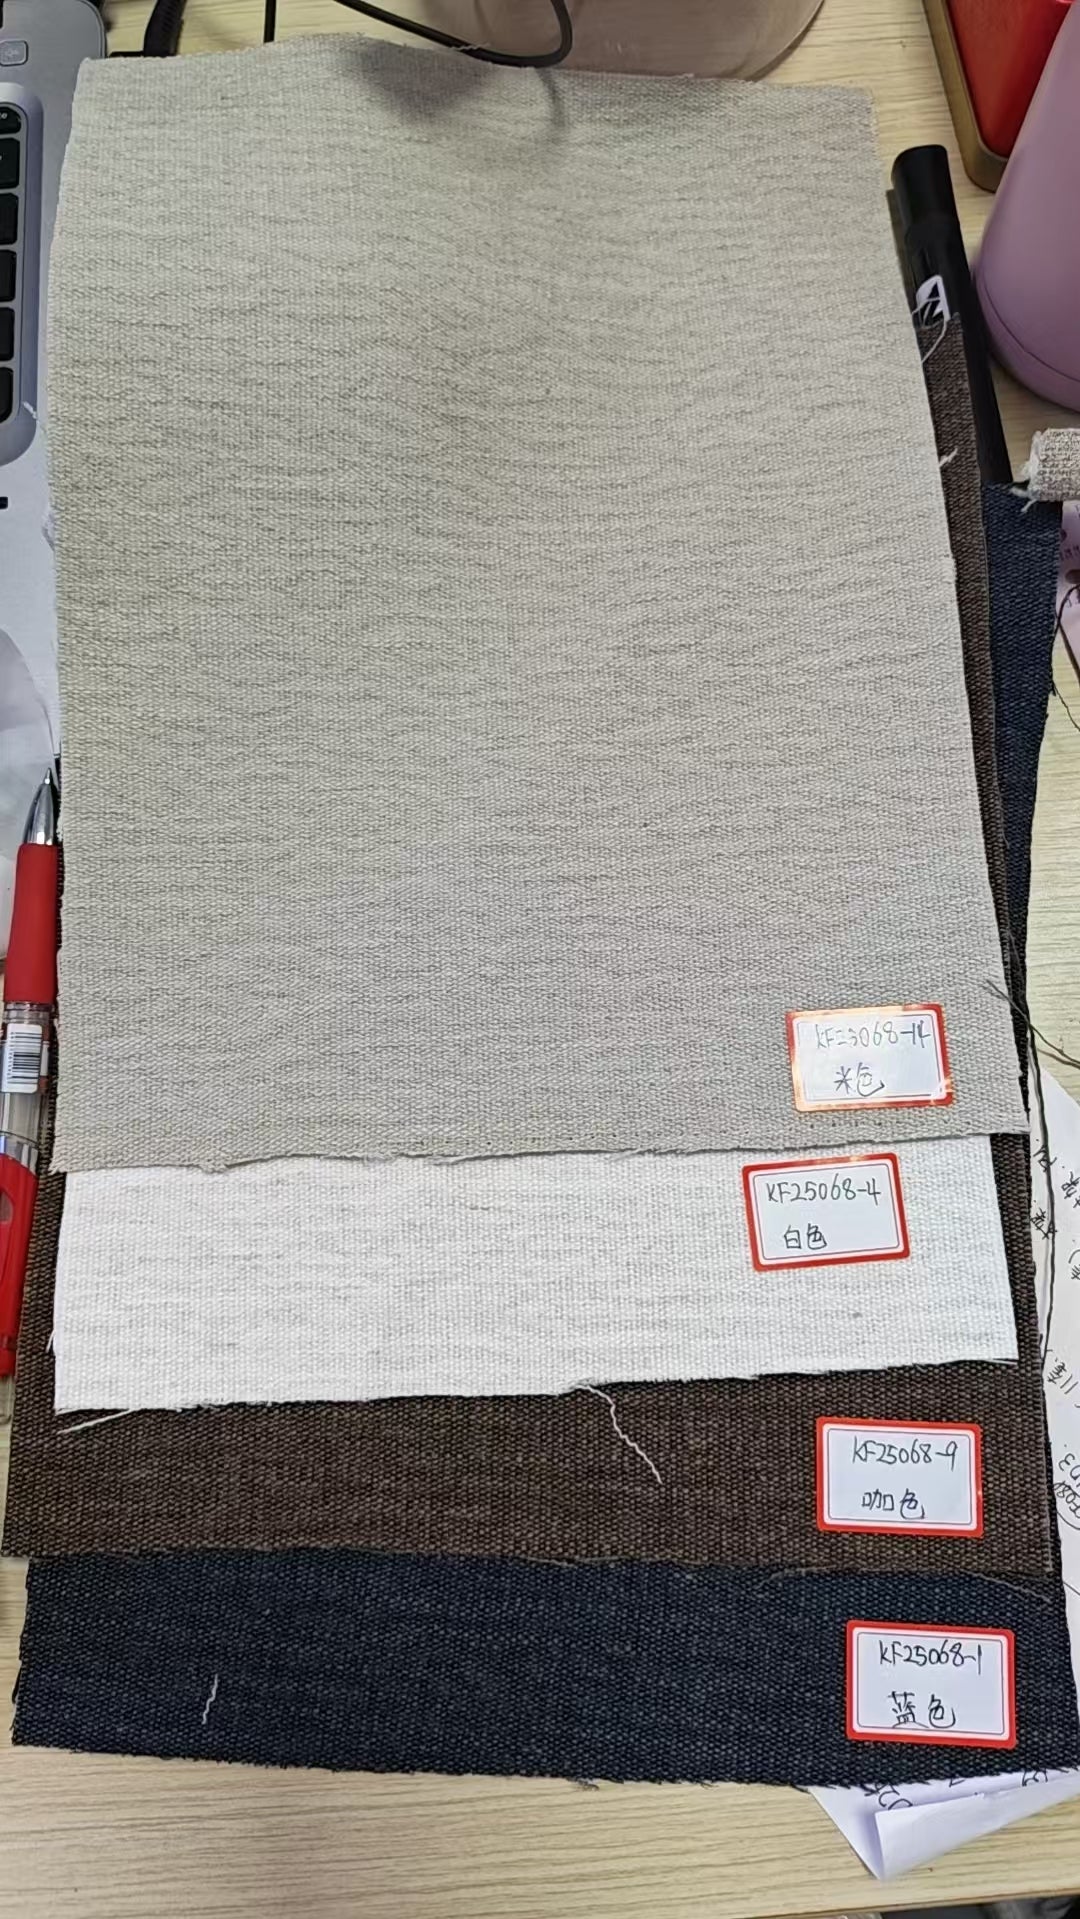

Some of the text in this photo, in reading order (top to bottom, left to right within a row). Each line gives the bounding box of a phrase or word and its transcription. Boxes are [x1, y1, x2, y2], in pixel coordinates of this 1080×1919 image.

[834, 1062, 885, 1097] 米色
[766, 1173, 881, 1206] KF25068-4
[783, 1223, 828, 1250] 白色
[852, 1435, 958, 1472] KF25068-9
[861, 1488, 926, 1520] 咖色
[879, 1639, 982, 1675] KF25068-1
[888, 1691, 956, 1729] 蓝色
